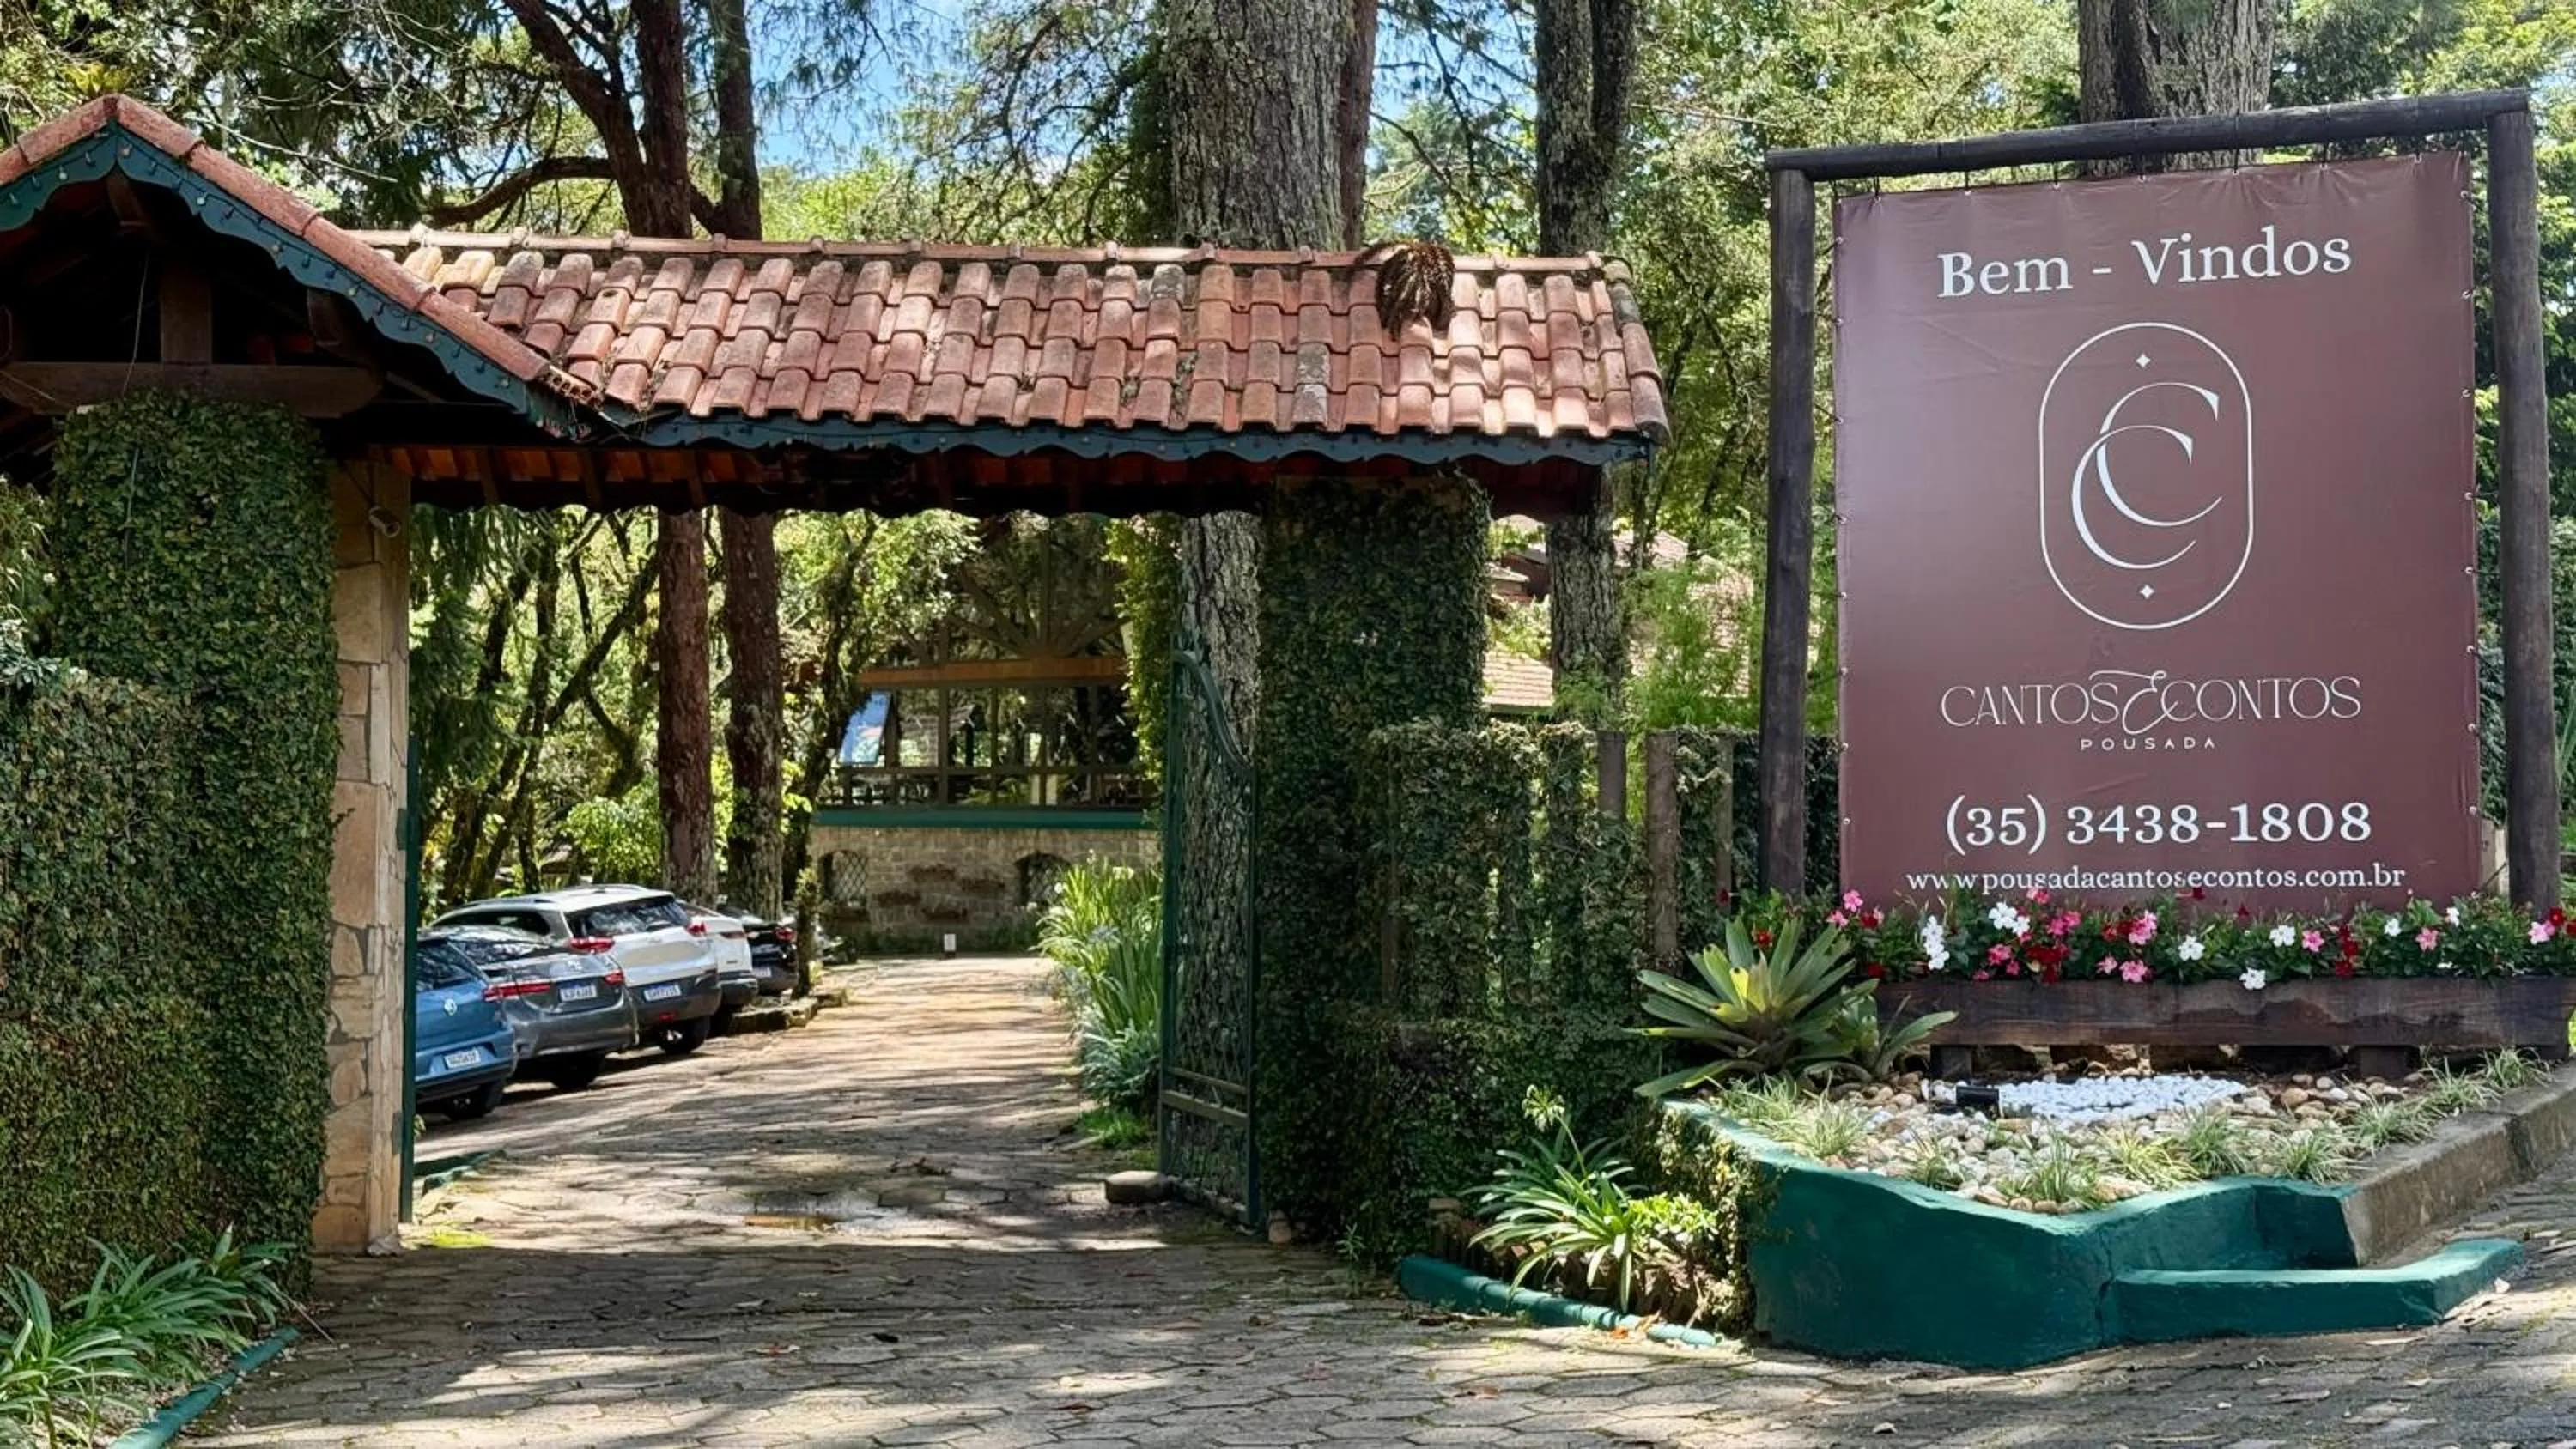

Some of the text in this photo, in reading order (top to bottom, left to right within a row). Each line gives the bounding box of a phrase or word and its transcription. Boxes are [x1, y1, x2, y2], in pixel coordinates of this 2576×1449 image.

[1937, 252, 2074, 298] Bem
[2130, 224, 2352, 285] Vindos
[2080, 736, 2216, 752] POUSADA
[1947, 793, 2372, 856] (35) 3438-1808
[1905, 862, 2406, 895] wwwpousadacantosecontos.com.br
